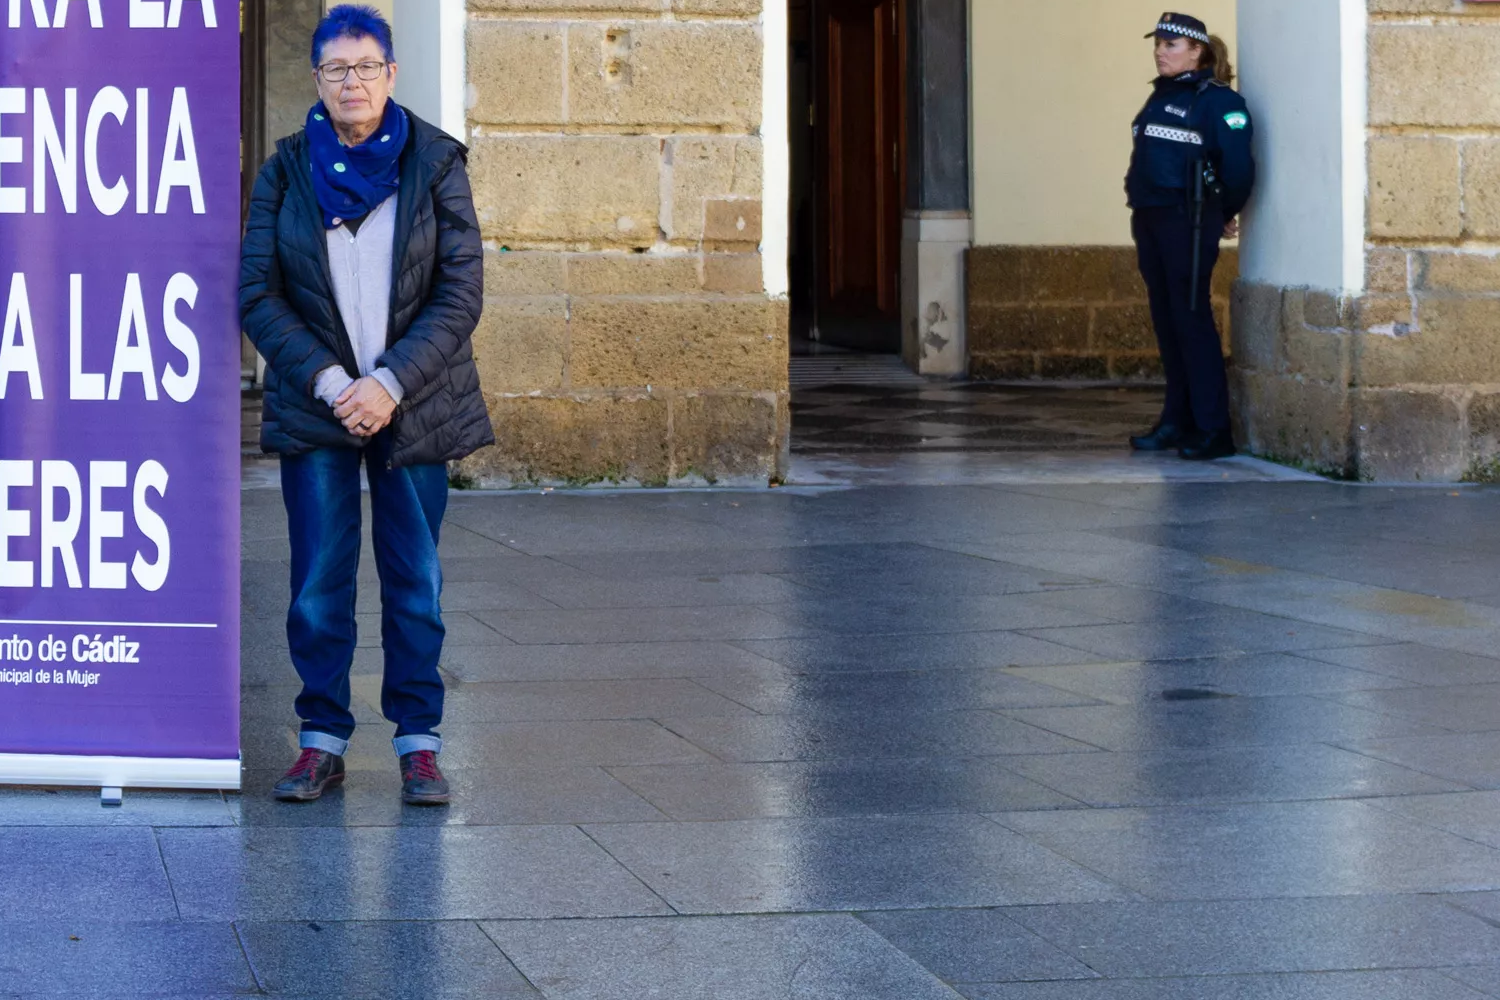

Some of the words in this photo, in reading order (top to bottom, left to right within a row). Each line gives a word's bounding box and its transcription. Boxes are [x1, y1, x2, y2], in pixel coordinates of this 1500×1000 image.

[69, 272, 200, 403] LAS
[37, 633, 67, 662] de
[71, 633, 140, 664] Cádiz
[35, 668, 51, 684] de
[52, 669, 64, 684] la
[66, 669, 101, 688] Mujer
